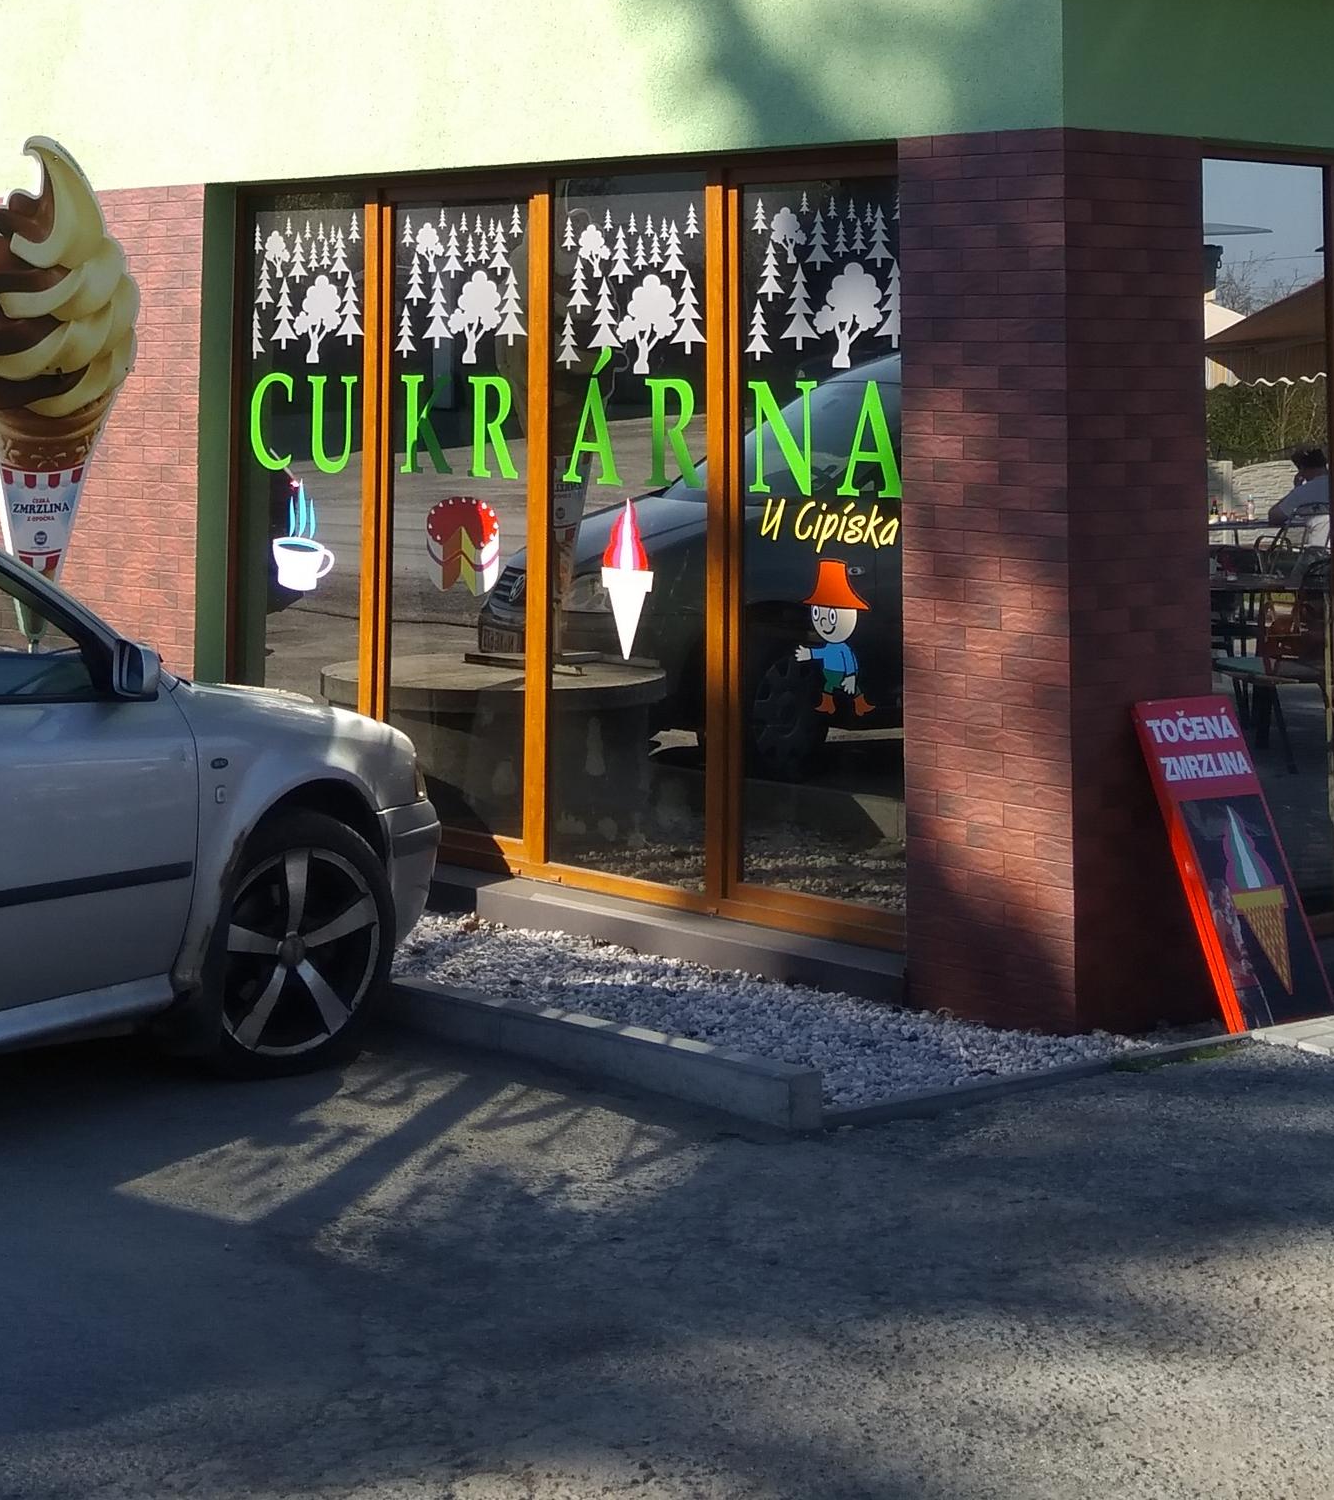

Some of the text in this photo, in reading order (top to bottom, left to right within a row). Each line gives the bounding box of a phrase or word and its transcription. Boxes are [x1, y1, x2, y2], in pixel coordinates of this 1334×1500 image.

[250, 347, 903, 499] CUKRÁRNA
[12, 502, 70, 514] ZMRZLINA
[761, 498, 900, 553] U Cipíska
[1145, 706, 1239, 743] TOČENÁ
[1159, 750, 1252, 781] ZMRZLINA
